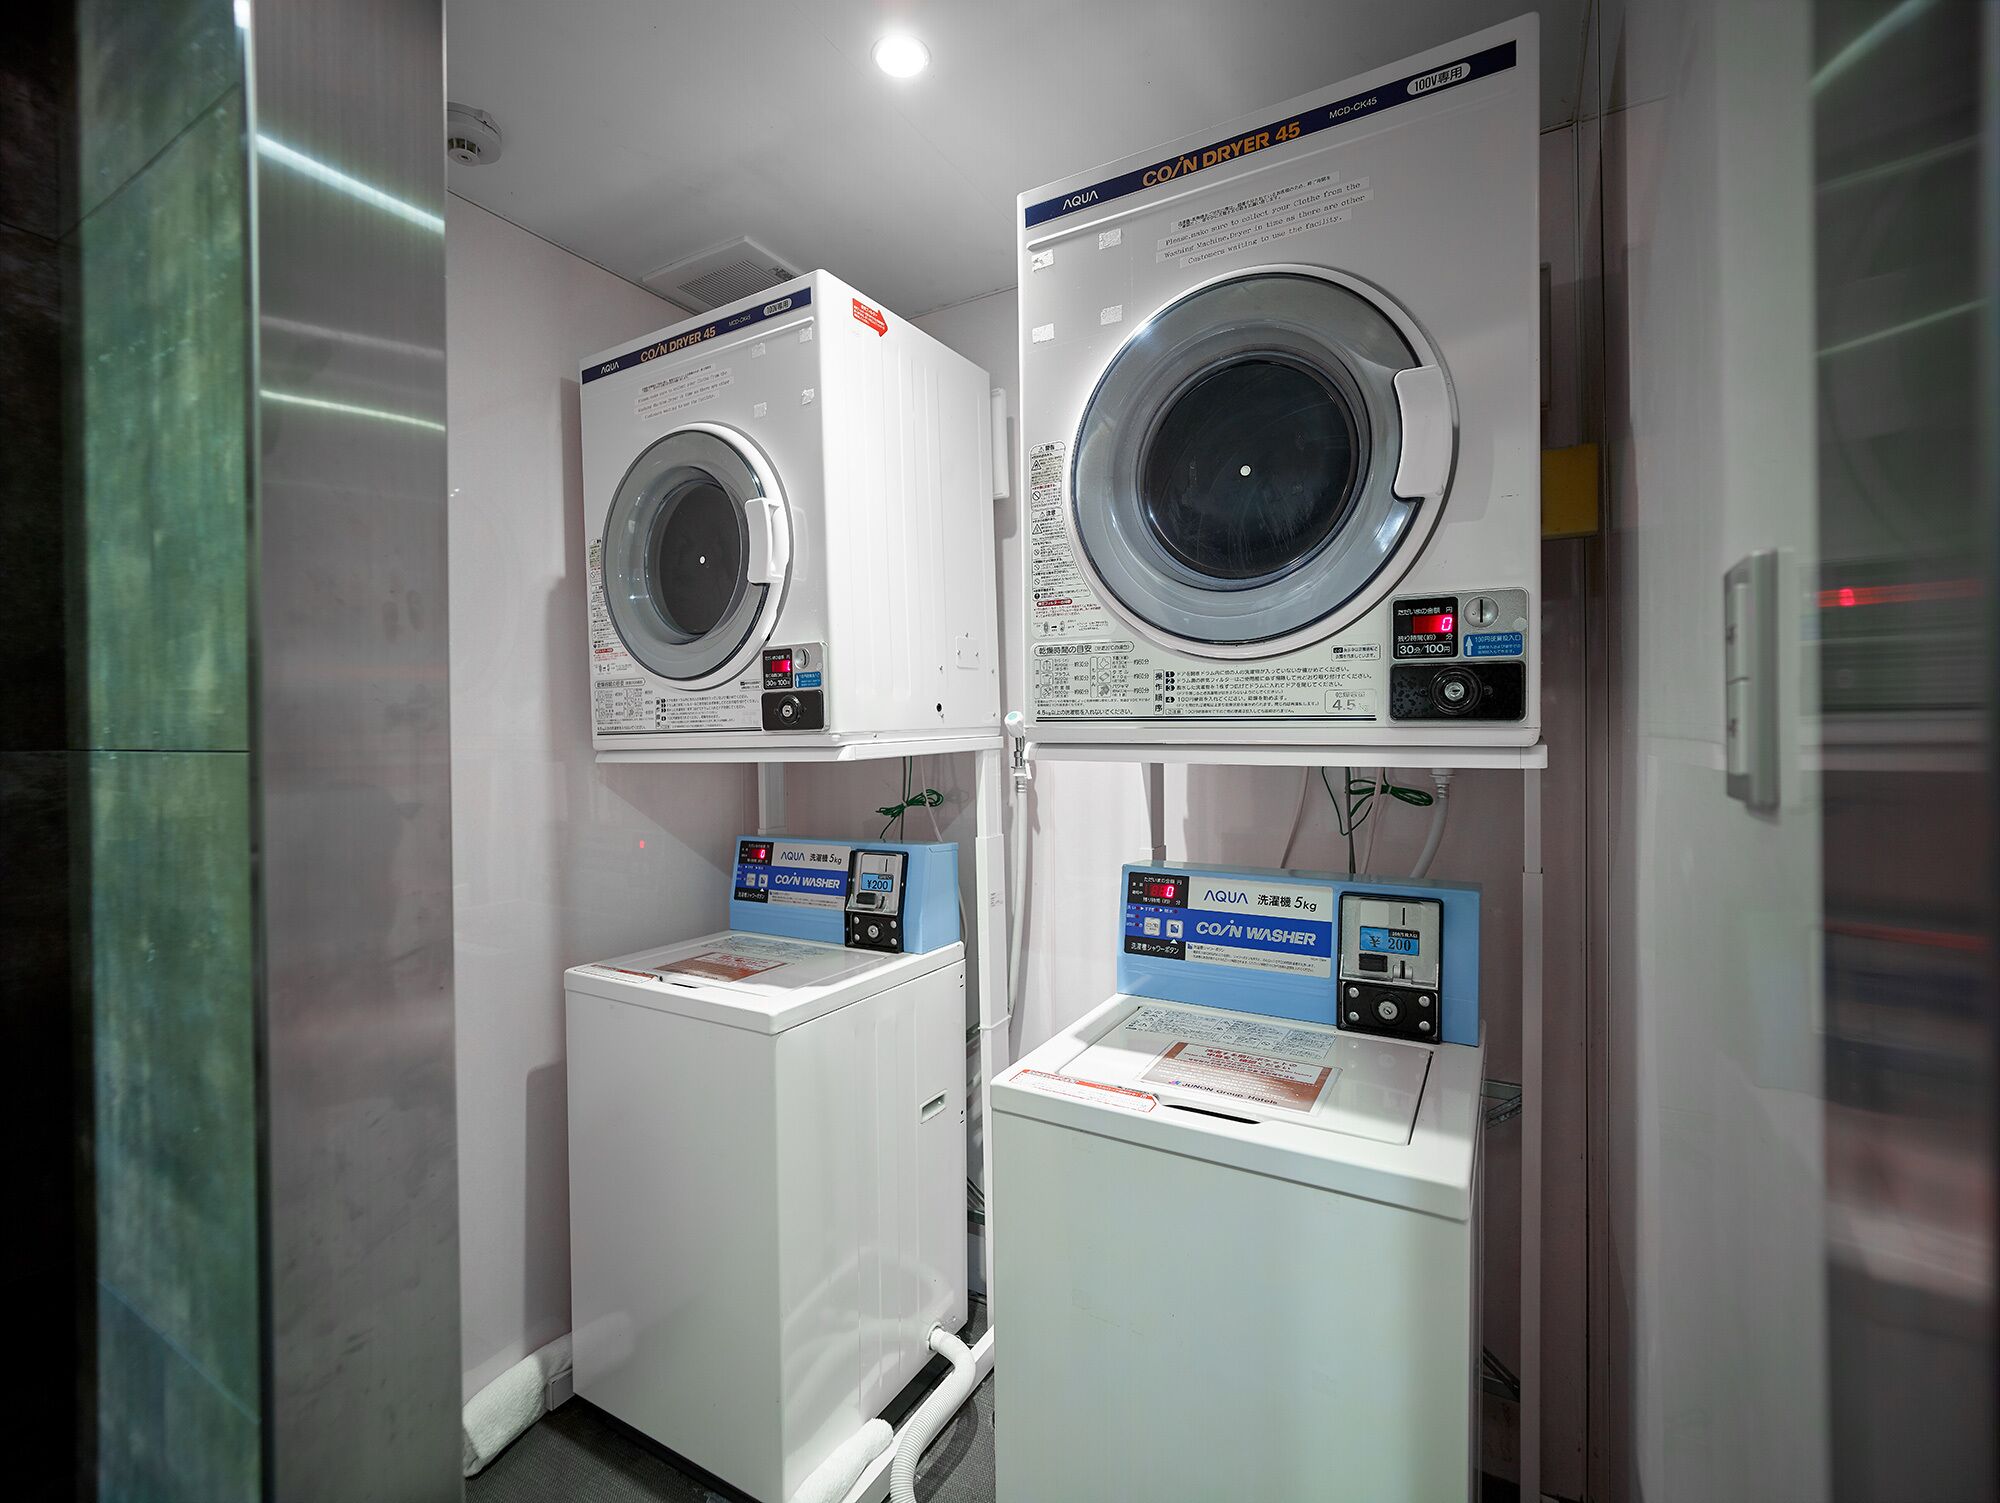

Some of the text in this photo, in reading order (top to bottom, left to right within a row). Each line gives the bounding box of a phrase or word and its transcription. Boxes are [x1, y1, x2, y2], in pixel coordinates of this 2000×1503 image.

[1063, 190, 1098, 210] AQUA
[1202, 131, 1269, 167] DRYER
[1276, 121, 1300, 142] 45
[1329, 97, 1377, 119] MCD-CK45
[1415, 66, 1463, 92] 100V専用
[1231, 218, 1239, 226] to
[1242, 210, 1268, 222] collect
[1272, 204, 1290, 214] your
[1294, 194, 1320, 207] Clothe
[1324, 188, 1342, 198] from
[1346, 182, 1360, 190] the
[1164, 246, 1194, 258] Washing
[1266, 218, 1283, 227] time
[1299, 208, 1320, 218] there
[1324, 203, 1338, 211] are
[1341, 195, 1365, 206] other
[1188, 248, 1225, 264] Customers
[1228, 239, 1257, 251] waiting
[1289, 226, 1302, 234] the
[600, 361, 619, 374] AQUA
[670, 333, 701, 352] DRYER
[703, 326, 716, 338] 45
[1442, 617, 1452, 631] 0
[781, 852, 805, 861] AQUA
[829, 854, 842, 864] 5kg
[803, 877, 840, 888] WASHER
[868, 880, 888, 889] ¥200
[1204, 890, 1317, 912] AQUA 洗濯機 5kg
[1247, 927, 1316, 946] WASHER
[1131, 942, 1180, 954] 洗濯槽シャワーボタン
[1388, 939, 1411, 951] 200
[1216, 1090, 1243, 1098] Group
